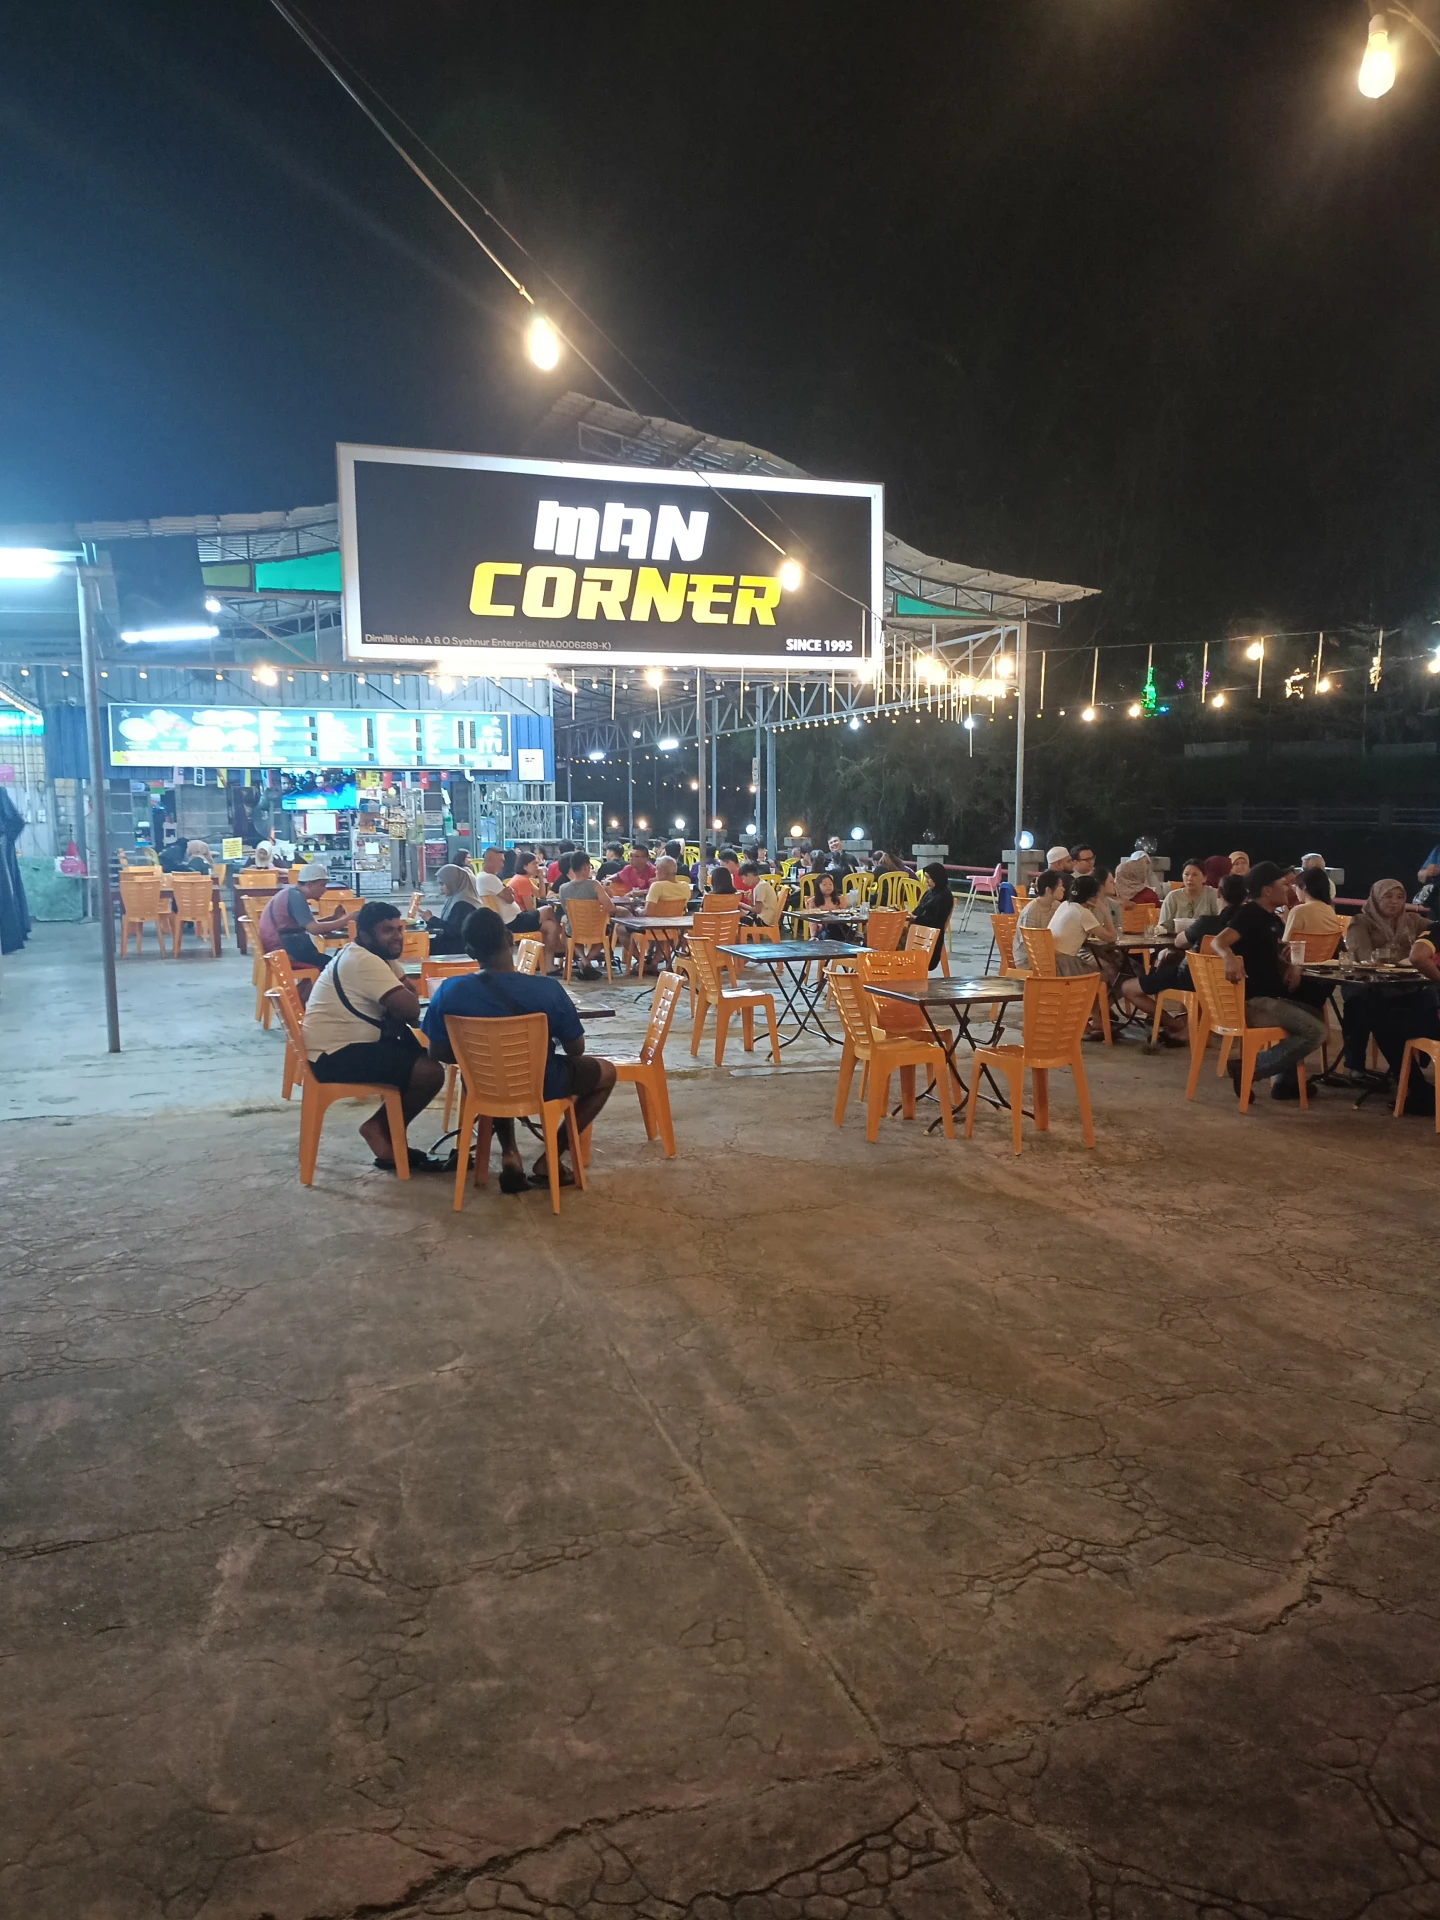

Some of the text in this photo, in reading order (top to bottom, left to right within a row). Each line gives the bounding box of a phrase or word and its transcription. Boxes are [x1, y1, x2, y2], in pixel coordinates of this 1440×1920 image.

[469, 561, 783, 626] CORNER
[364, 633, 398, 643] Dimiliki
[399, 634, 419, 644] oleh
[424, 635, 433, 644] A
[433, 635, 441, 644] &
[451, 636, 490, 647] Syahnur
[491, 638, 538, 649] Enterprise
[785, 638, 854, 653] SINCE 1995
